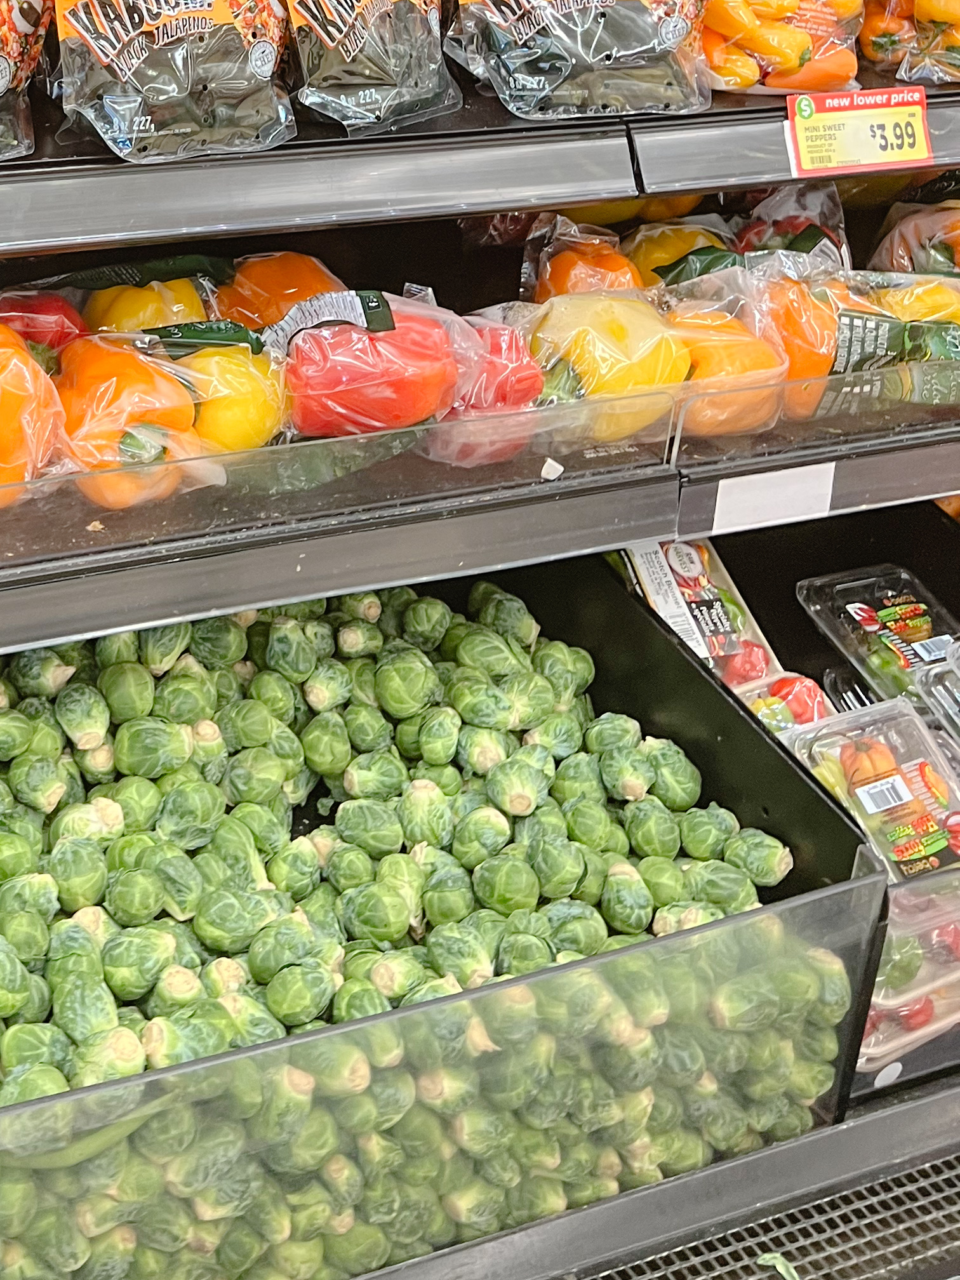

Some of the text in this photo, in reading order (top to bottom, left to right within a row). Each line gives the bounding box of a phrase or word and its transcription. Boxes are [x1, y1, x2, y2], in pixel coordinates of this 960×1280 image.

[154, 17, 213, 47] JALAPENOS
[665, 25, 687, 41] CHEF
[254, 52, 275, 69] CHEF
[825, 90, 920, 108] new lower price
[804, 123, 846, 133] MINI SWEET
[869, 120, 917, 152] $3.99
[805, 133, 837, 142] PEPPERS
[685, 551, 696, 565] RAW
[652, 550, 668, 578] Scotch
[665, 579, 682, 609] Bonnet
